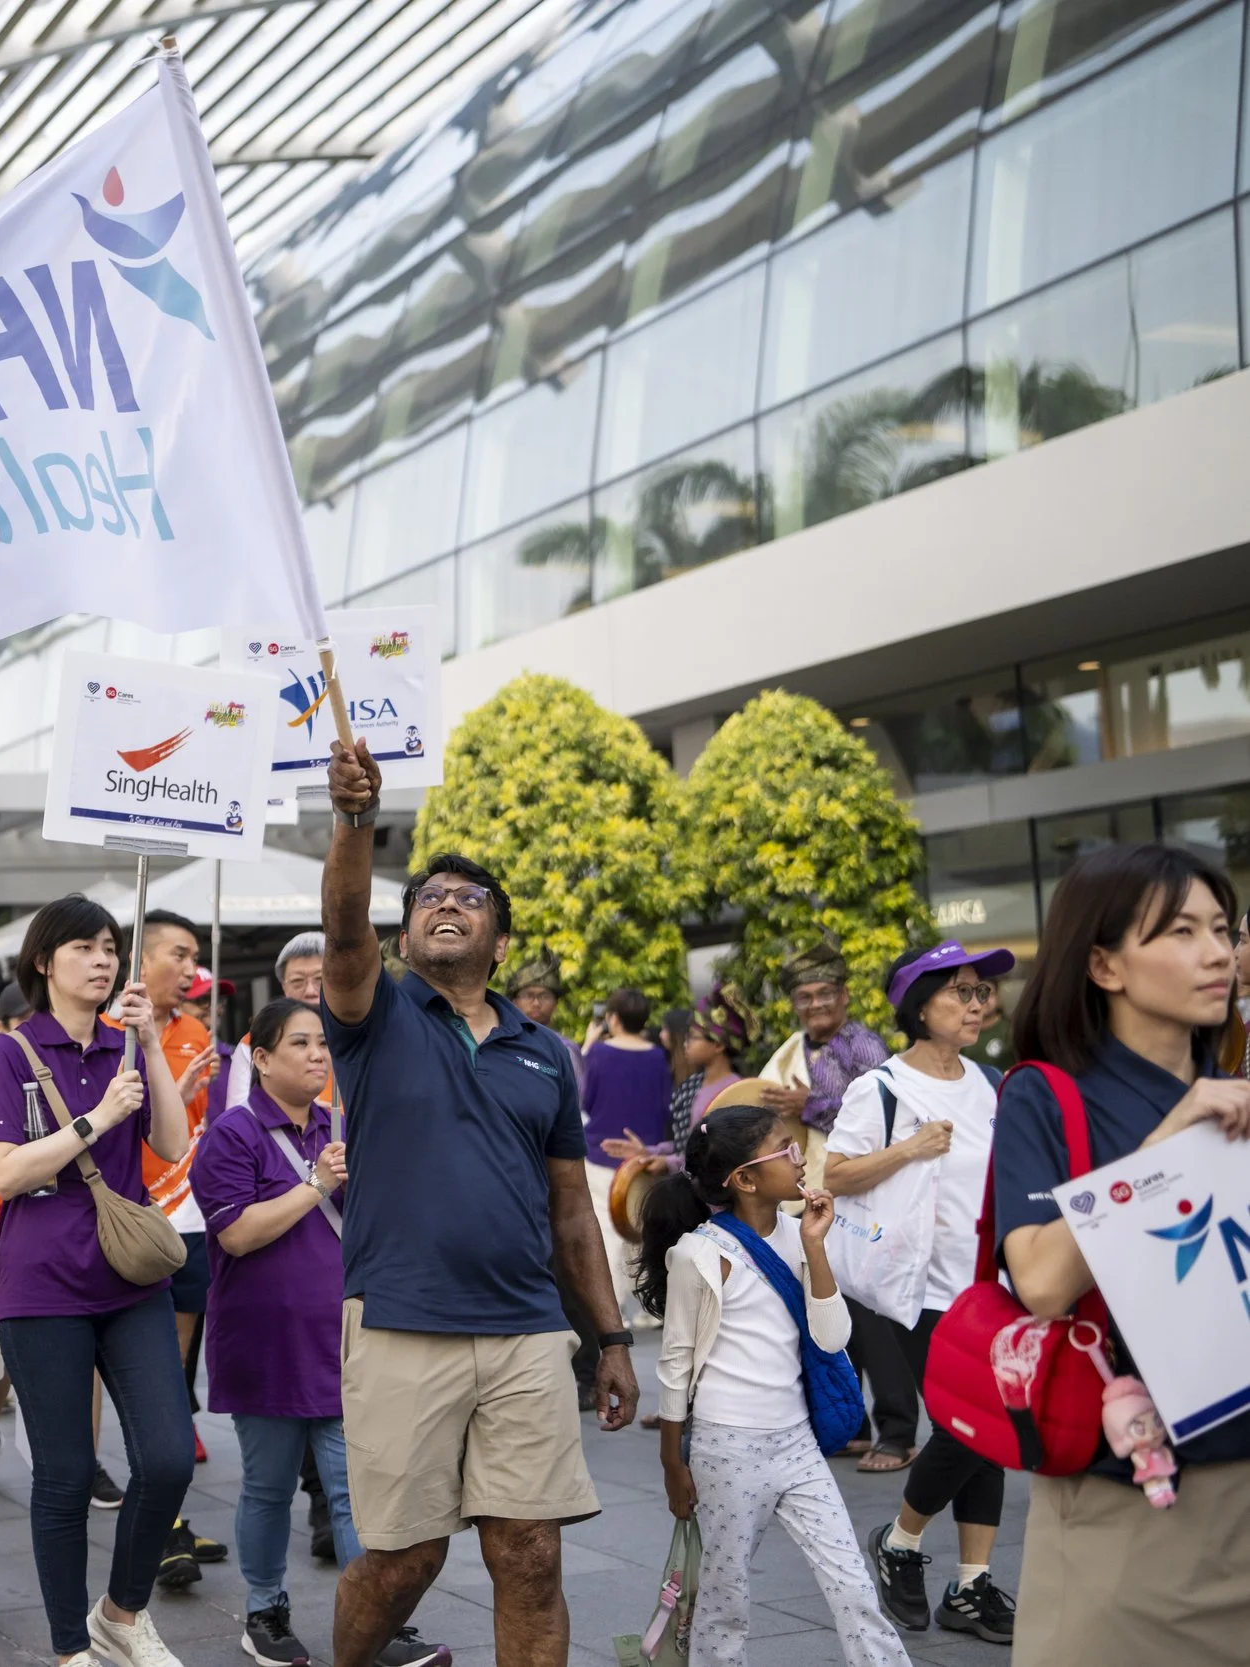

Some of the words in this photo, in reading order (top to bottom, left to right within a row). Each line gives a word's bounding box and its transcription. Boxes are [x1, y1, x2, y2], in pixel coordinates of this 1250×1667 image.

[106, 688, 116, 698] SG
[118, 691, 134, 699] Cares
[376, 720, 399, 728] Authority
[105, 769, 218, 805] SingHealth
[1112, 1184, 1130, 1201] SG
[1133, 1170, 1165, 1190] Cares
